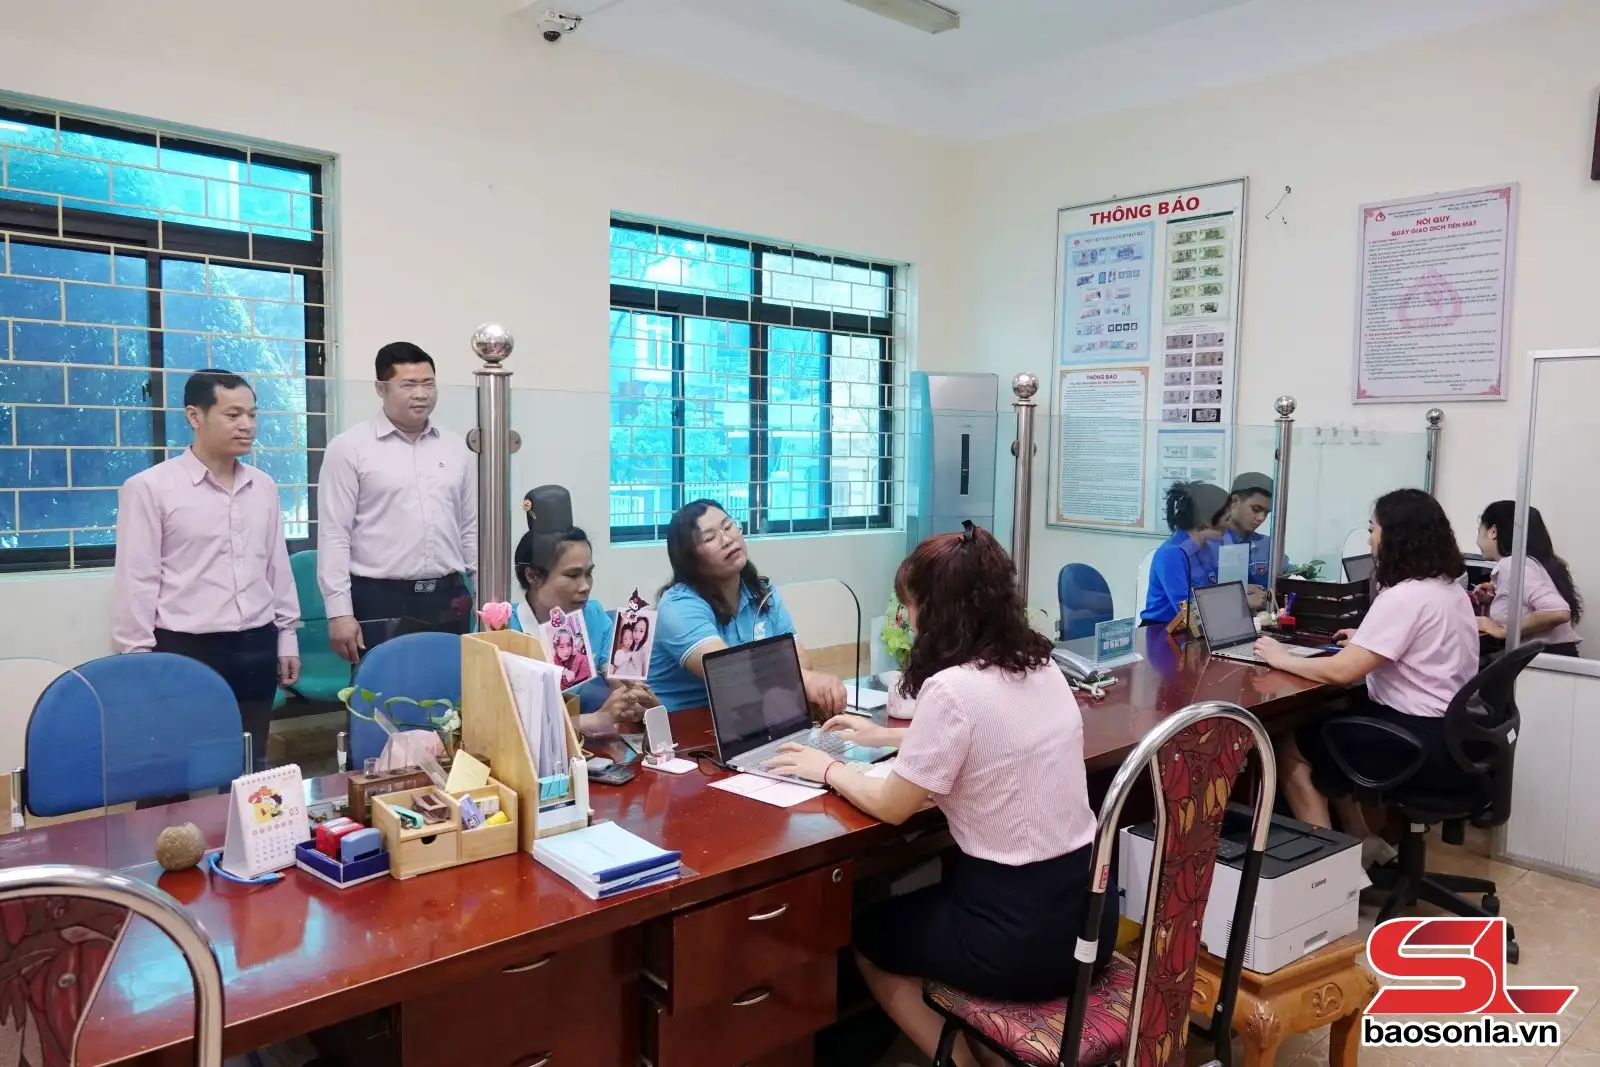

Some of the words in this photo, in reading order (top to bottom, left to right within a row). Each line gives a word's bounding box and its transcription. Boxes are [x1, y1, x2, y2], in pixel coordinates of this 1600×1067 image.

[1089, 204, 1152, 225] THÔNG
[1158, 195, 1200, 215] BÁO
[1432, 215, 1451, 223] QUY
[289, 807, 299, 816] 03
[1311, 878, 1327, 889] Canon
